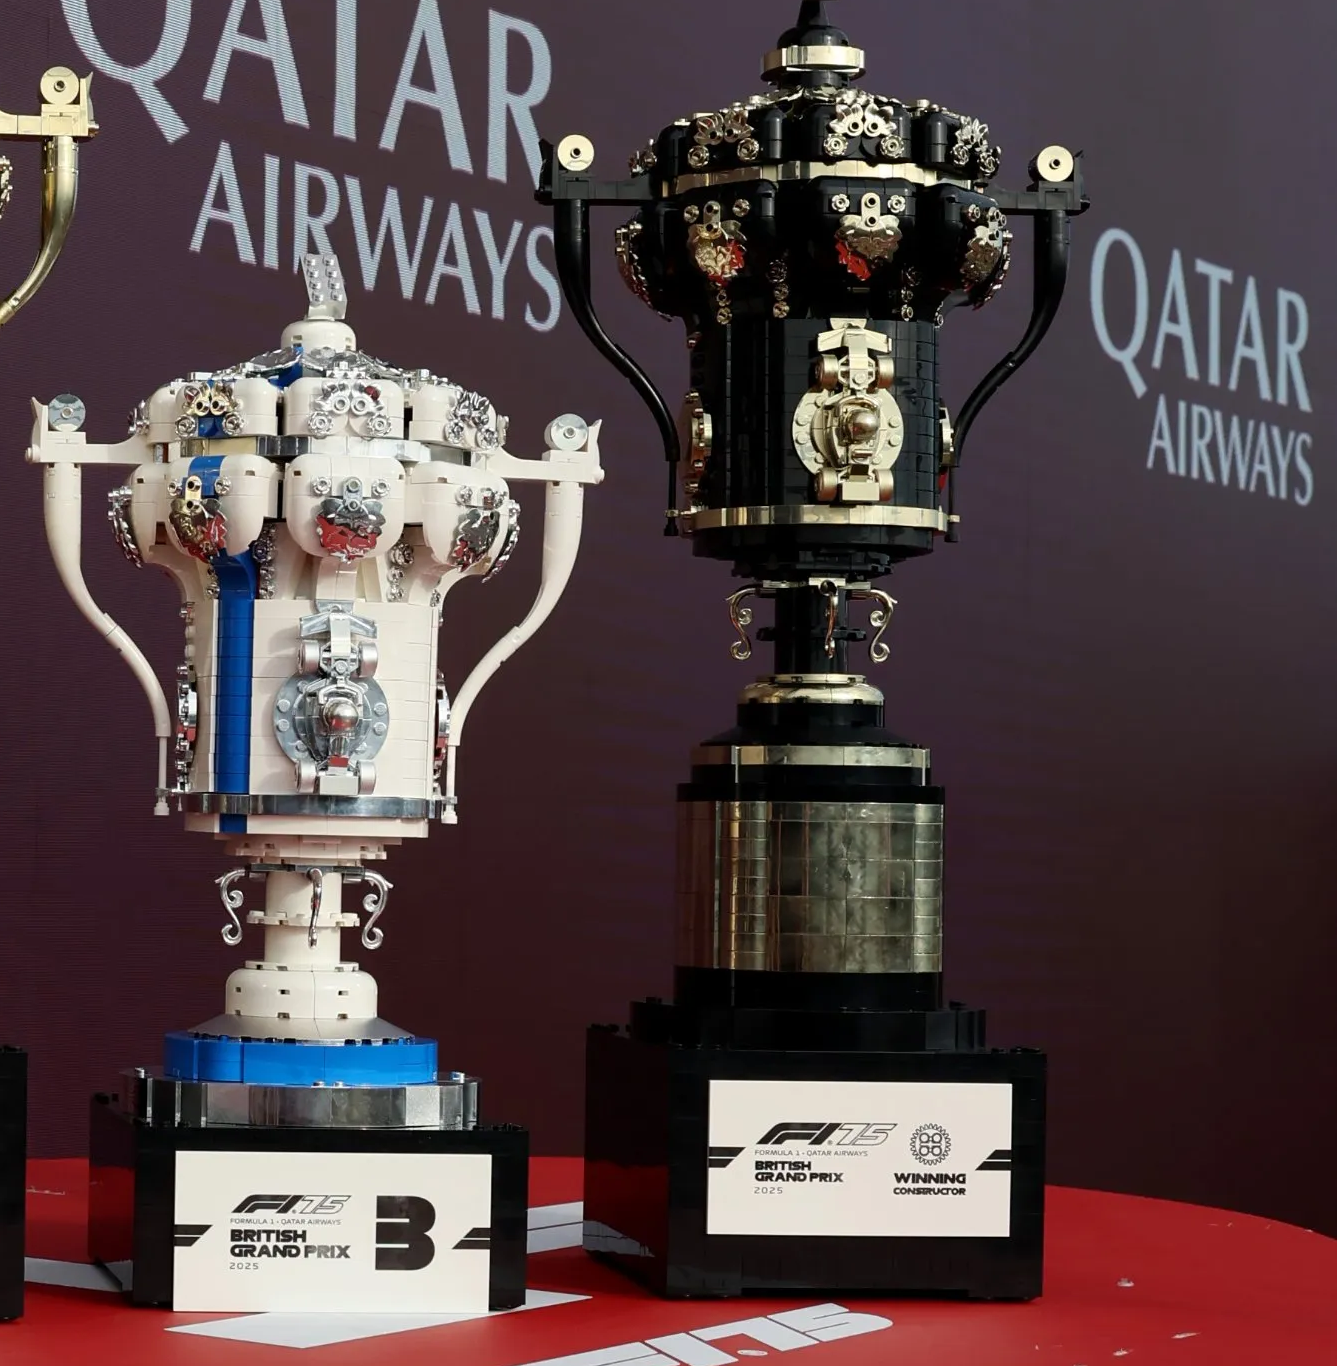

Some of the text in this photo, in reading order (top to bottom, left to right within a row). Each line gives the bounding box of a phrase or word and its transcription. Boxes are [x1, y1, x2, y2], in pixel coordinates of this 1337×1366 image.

[189, 140, 562, 333] AIRWAYS
[1089, 227, 1313, 413] QATAR
[1146, 393, 1314, 506] AIRWAYS
[754, 1160, 812, 1172] BRITISH
[754, 1171, 845, 1183] GRAND PRIX
[893, 1172, 967, 1185] WINNING
[754, 1186, 784, 1195] 2025
[893, 1187, 967, 1196] CONSTRUCTOR
[230, 1229, 307, 1243] BRITISH
[375, 1195, 436, 1271] 3
[230, 1244, 351, 1259] GRAND PRIX
[229, 1262, 259, 1270] 2025
